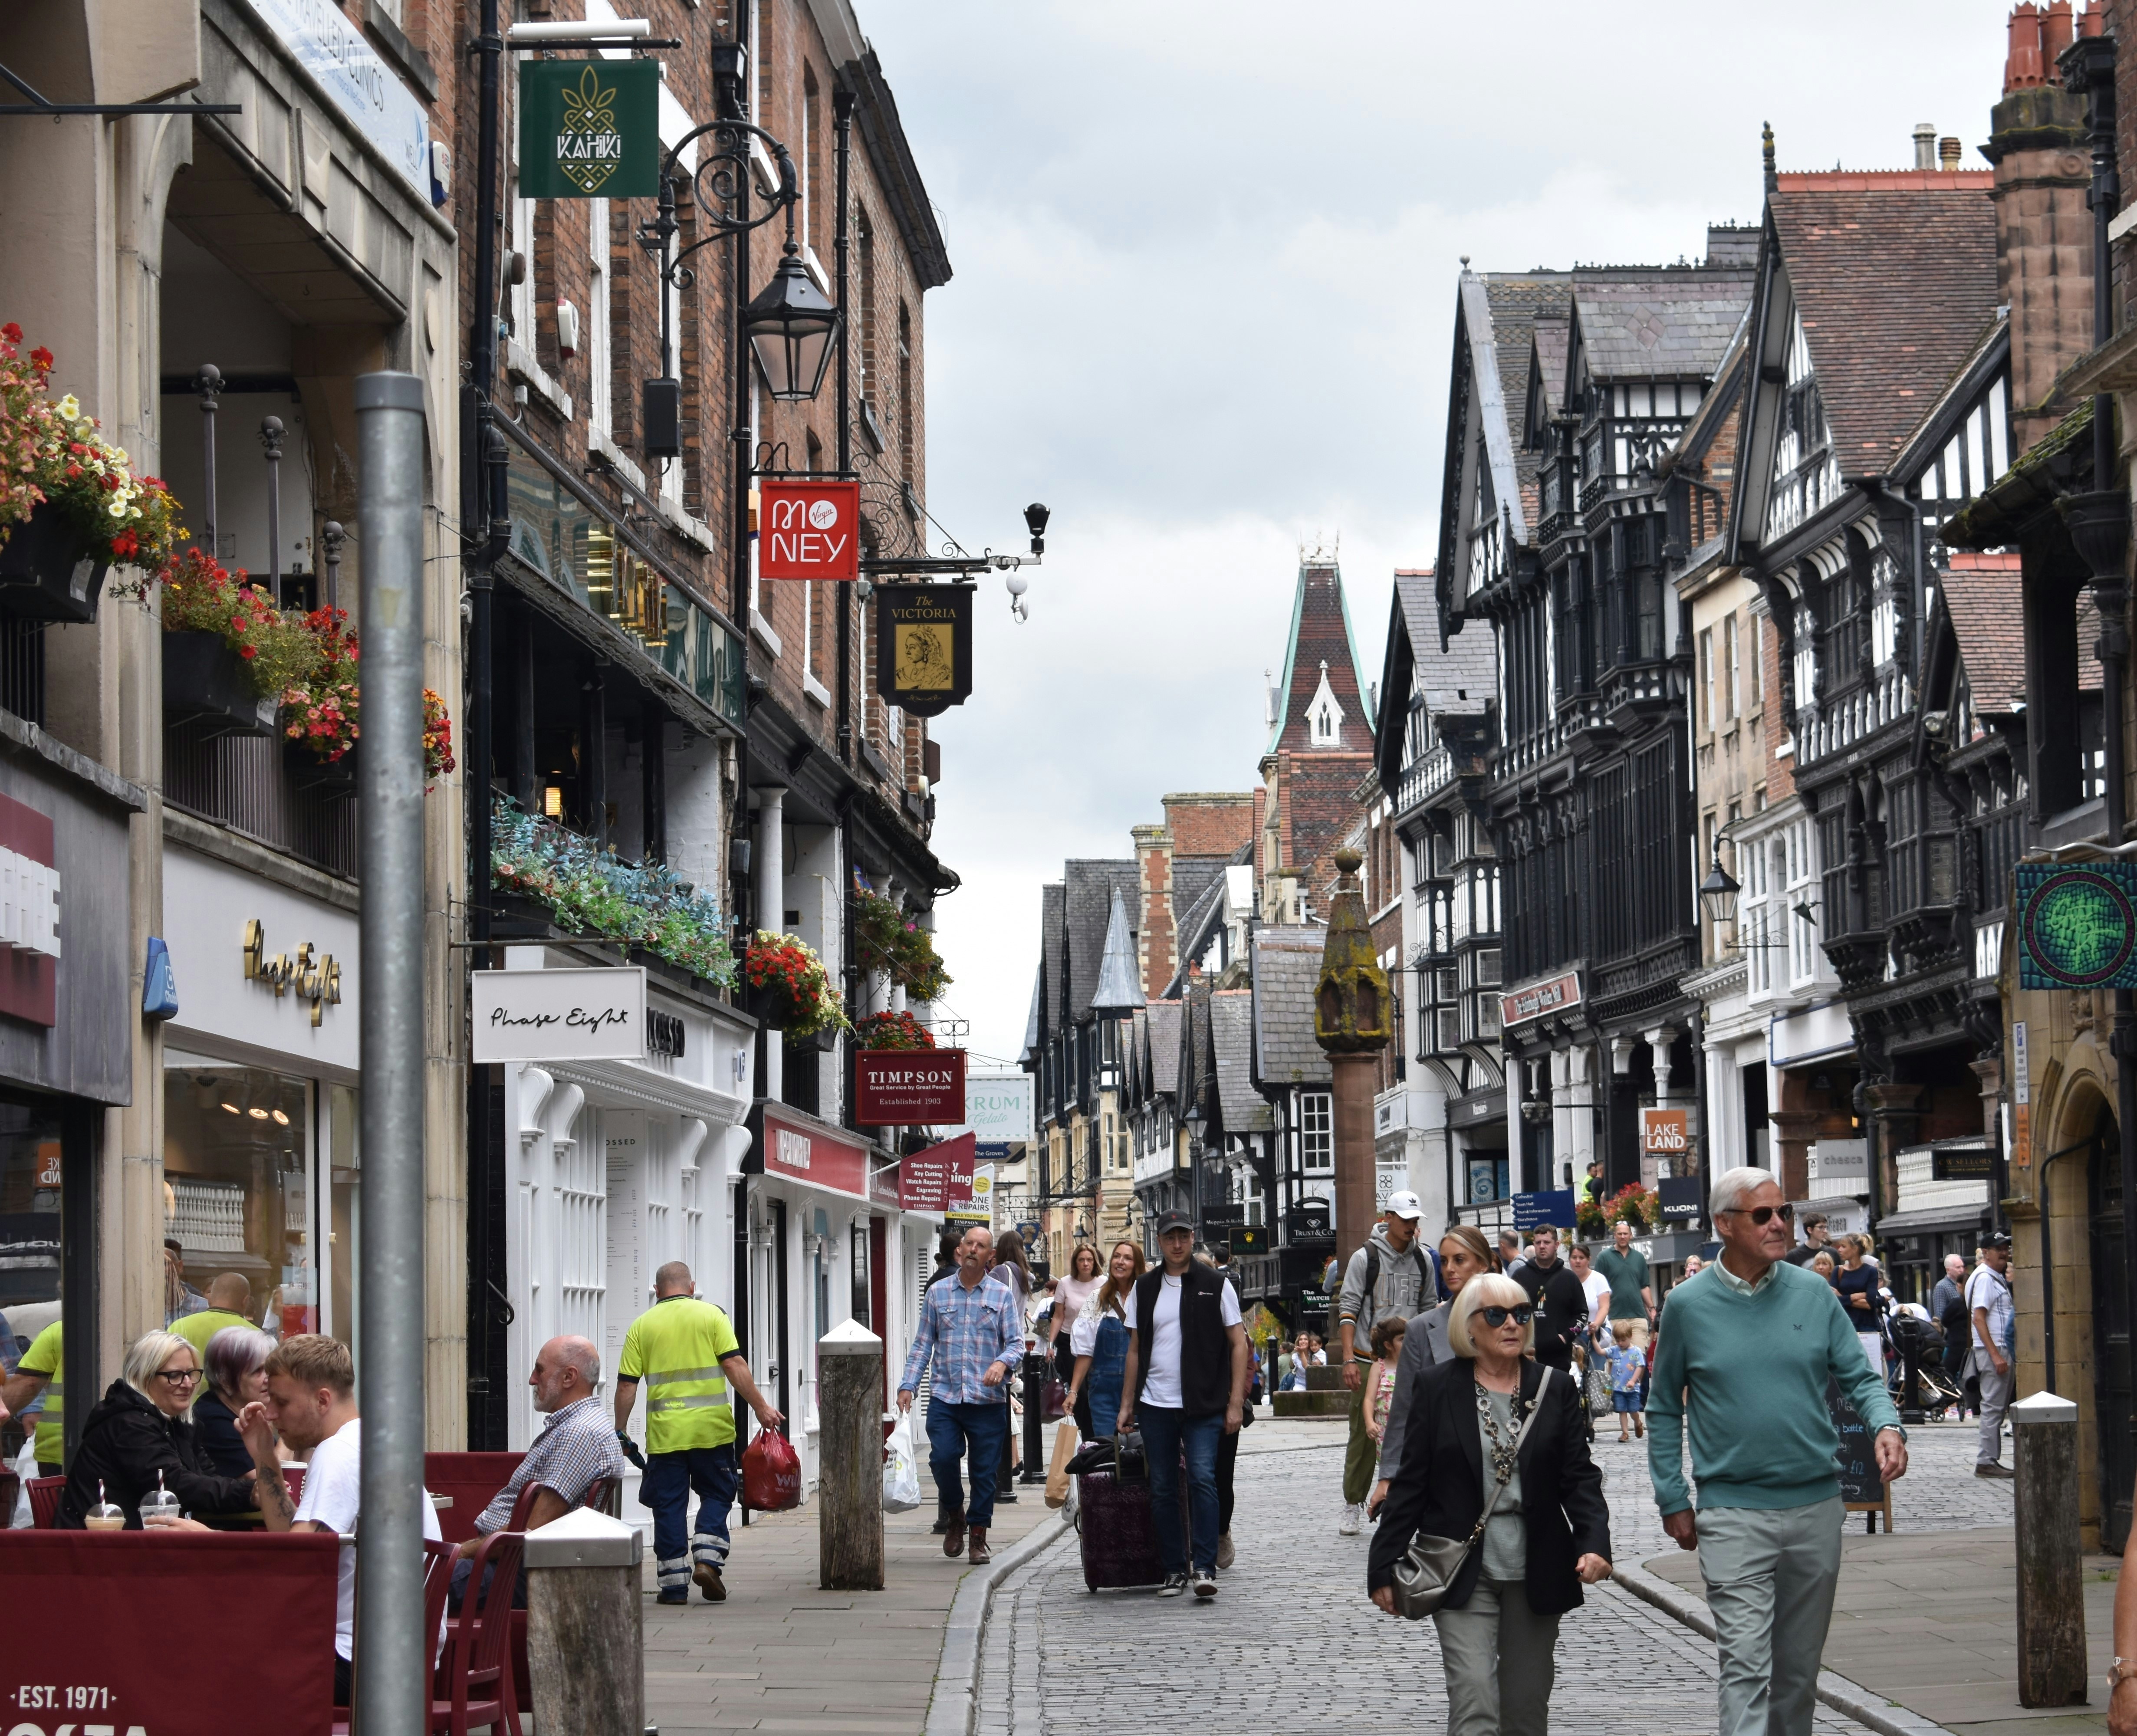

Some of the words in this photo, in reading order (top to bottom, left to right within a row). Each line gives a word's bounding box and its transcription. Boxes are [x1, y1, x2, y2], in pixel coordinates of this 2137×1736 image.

[348, 39, 383, 112] CLINICS
[404, 139, 418, 170] WELL
[812, 505, 834, 524] Virgin
[915, 596, 933, 606] The
[891, 608, 956, 618] VICTORIA
[2025, 905, 2035, 927] TASTE
[2032, 893, 2042, 905] OF
[2040, 873, 2077, 894] LOUISIANA
[2079, 874, 2101, 883] TASTE
[2101, 880, 2110, 890] OF
[2110, 888, 2134, 927] LOUISIANA
[491, 1007, 560, 1028] Phase
[565, 1008, 628, 1034] Eight
[868, 1071, 953, 1083] TIMPSON
[967, 1112, 1009, 1129] Gelato
[1647, 1124, 1679, 1136] LAKE
[1647, 1136, 1684, 1148] LAND
[1824, 1155, 1863, 1164] chesca
[1375, 1273, 1421, 1308] LIFE
[1842, 1422, 1864, 1433] bottle
[1850, 1460, 1864, 1475] £12
[20, 1685, 59, 1708] EST.
[66, 1686, 108, 1709] 1971
